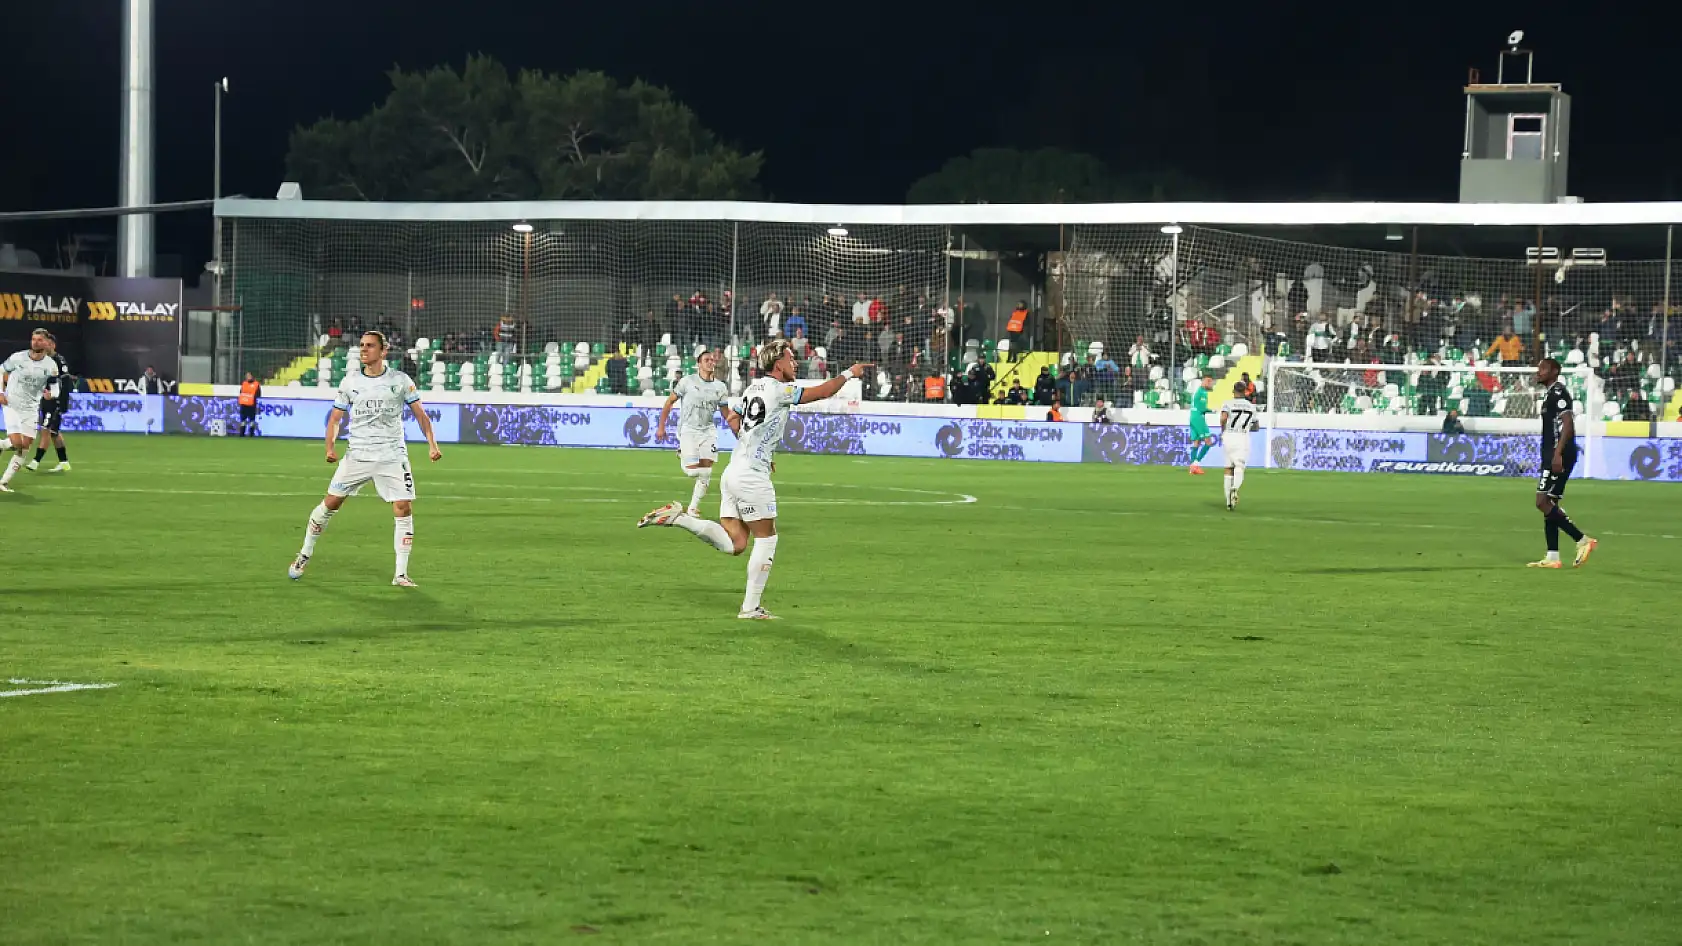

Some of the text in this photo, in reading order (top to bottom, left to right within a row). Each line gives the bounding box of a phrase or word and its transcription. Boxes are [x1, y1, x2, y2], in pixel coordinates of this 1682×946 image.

[24, 294, 83, 313] TALAY
[116, 301, 179, 315] TALAY
[114, 378, 176, 392] TAY
[1230, 409, 1253, 430] 77
[1394, 461, 1505, 475] suratkargo
